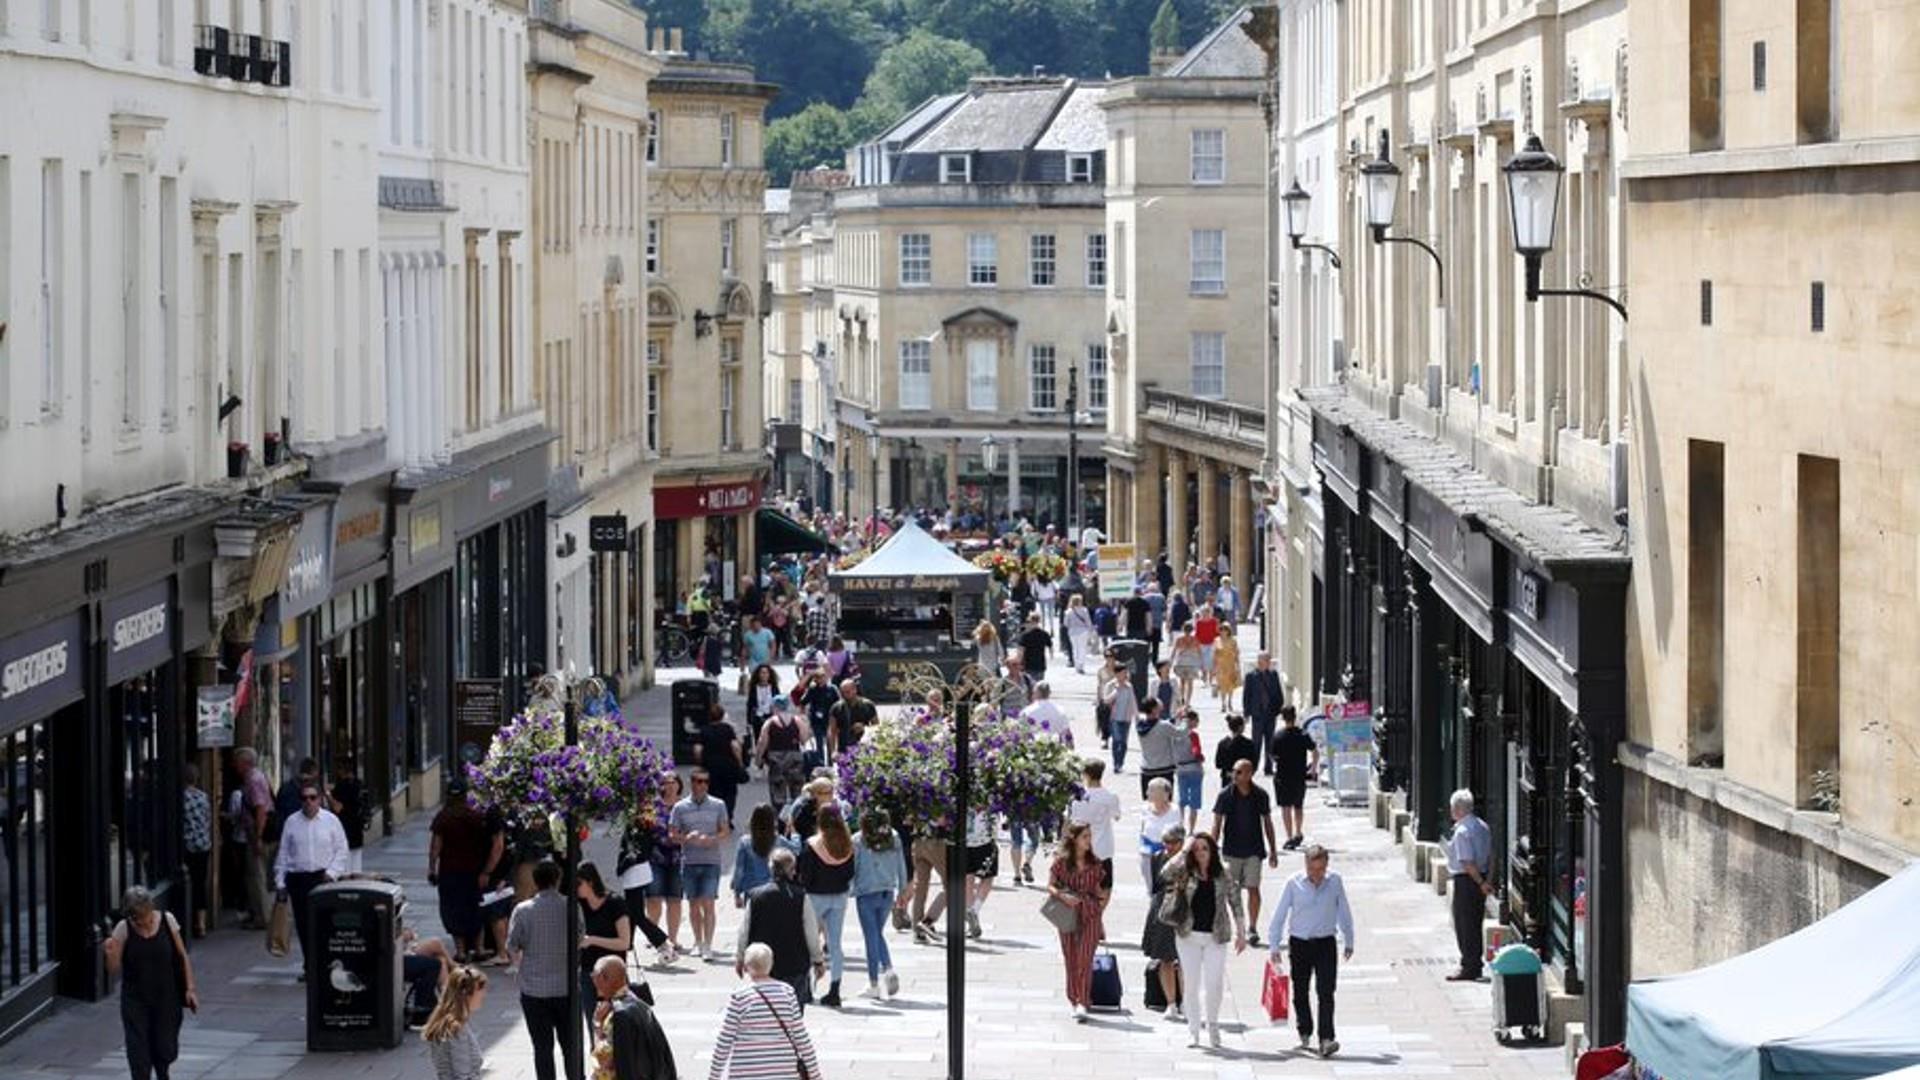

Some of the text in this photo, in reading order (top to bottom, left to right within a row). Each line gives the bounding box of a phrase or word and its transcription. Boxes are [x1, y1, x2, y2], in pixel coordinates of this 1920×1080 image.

[593, 527, 625, 540] COS
[113, 601, 166, 652] SKECHERS
[2, 640, 68, 698] SKECHERS
